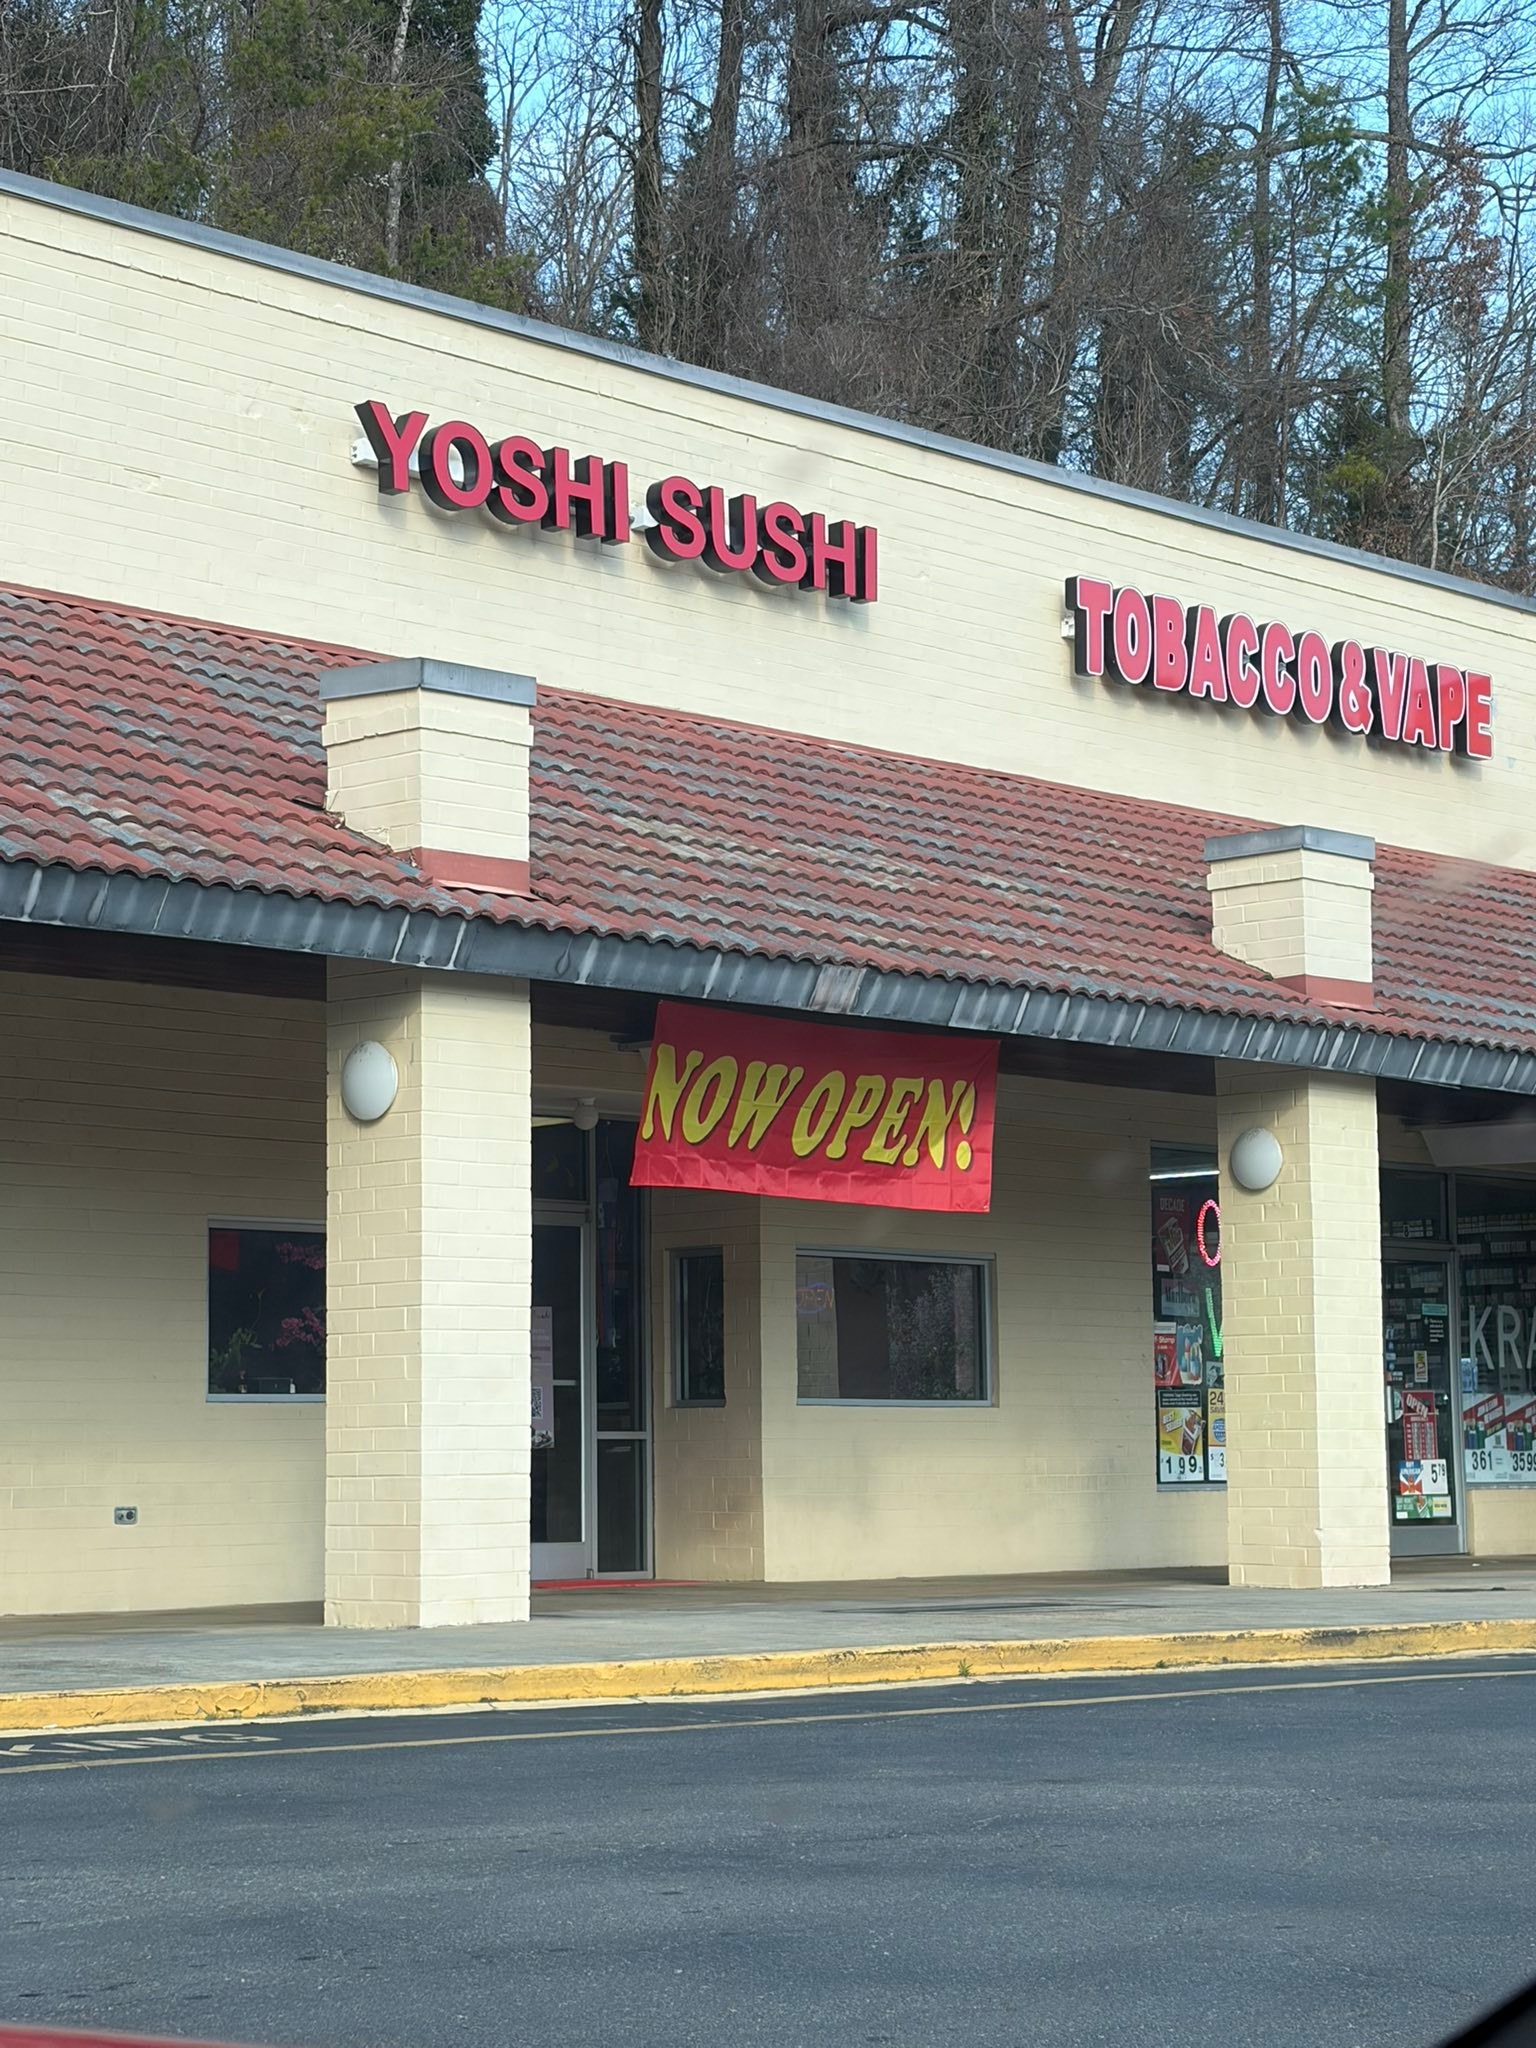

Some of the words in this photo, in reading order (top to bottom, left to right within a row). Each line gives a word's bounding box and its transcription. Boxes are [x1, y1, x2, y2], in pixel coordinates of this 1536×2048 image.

[354, 400, 629, 545] YOSHI
[646, 475, 877, 602] SUSHI
[642, 1042, 804, 1150] NOW
[791, 1070, 976, 1170] OPEN!
[1406, 1393, 1429, 1419] OPEN
